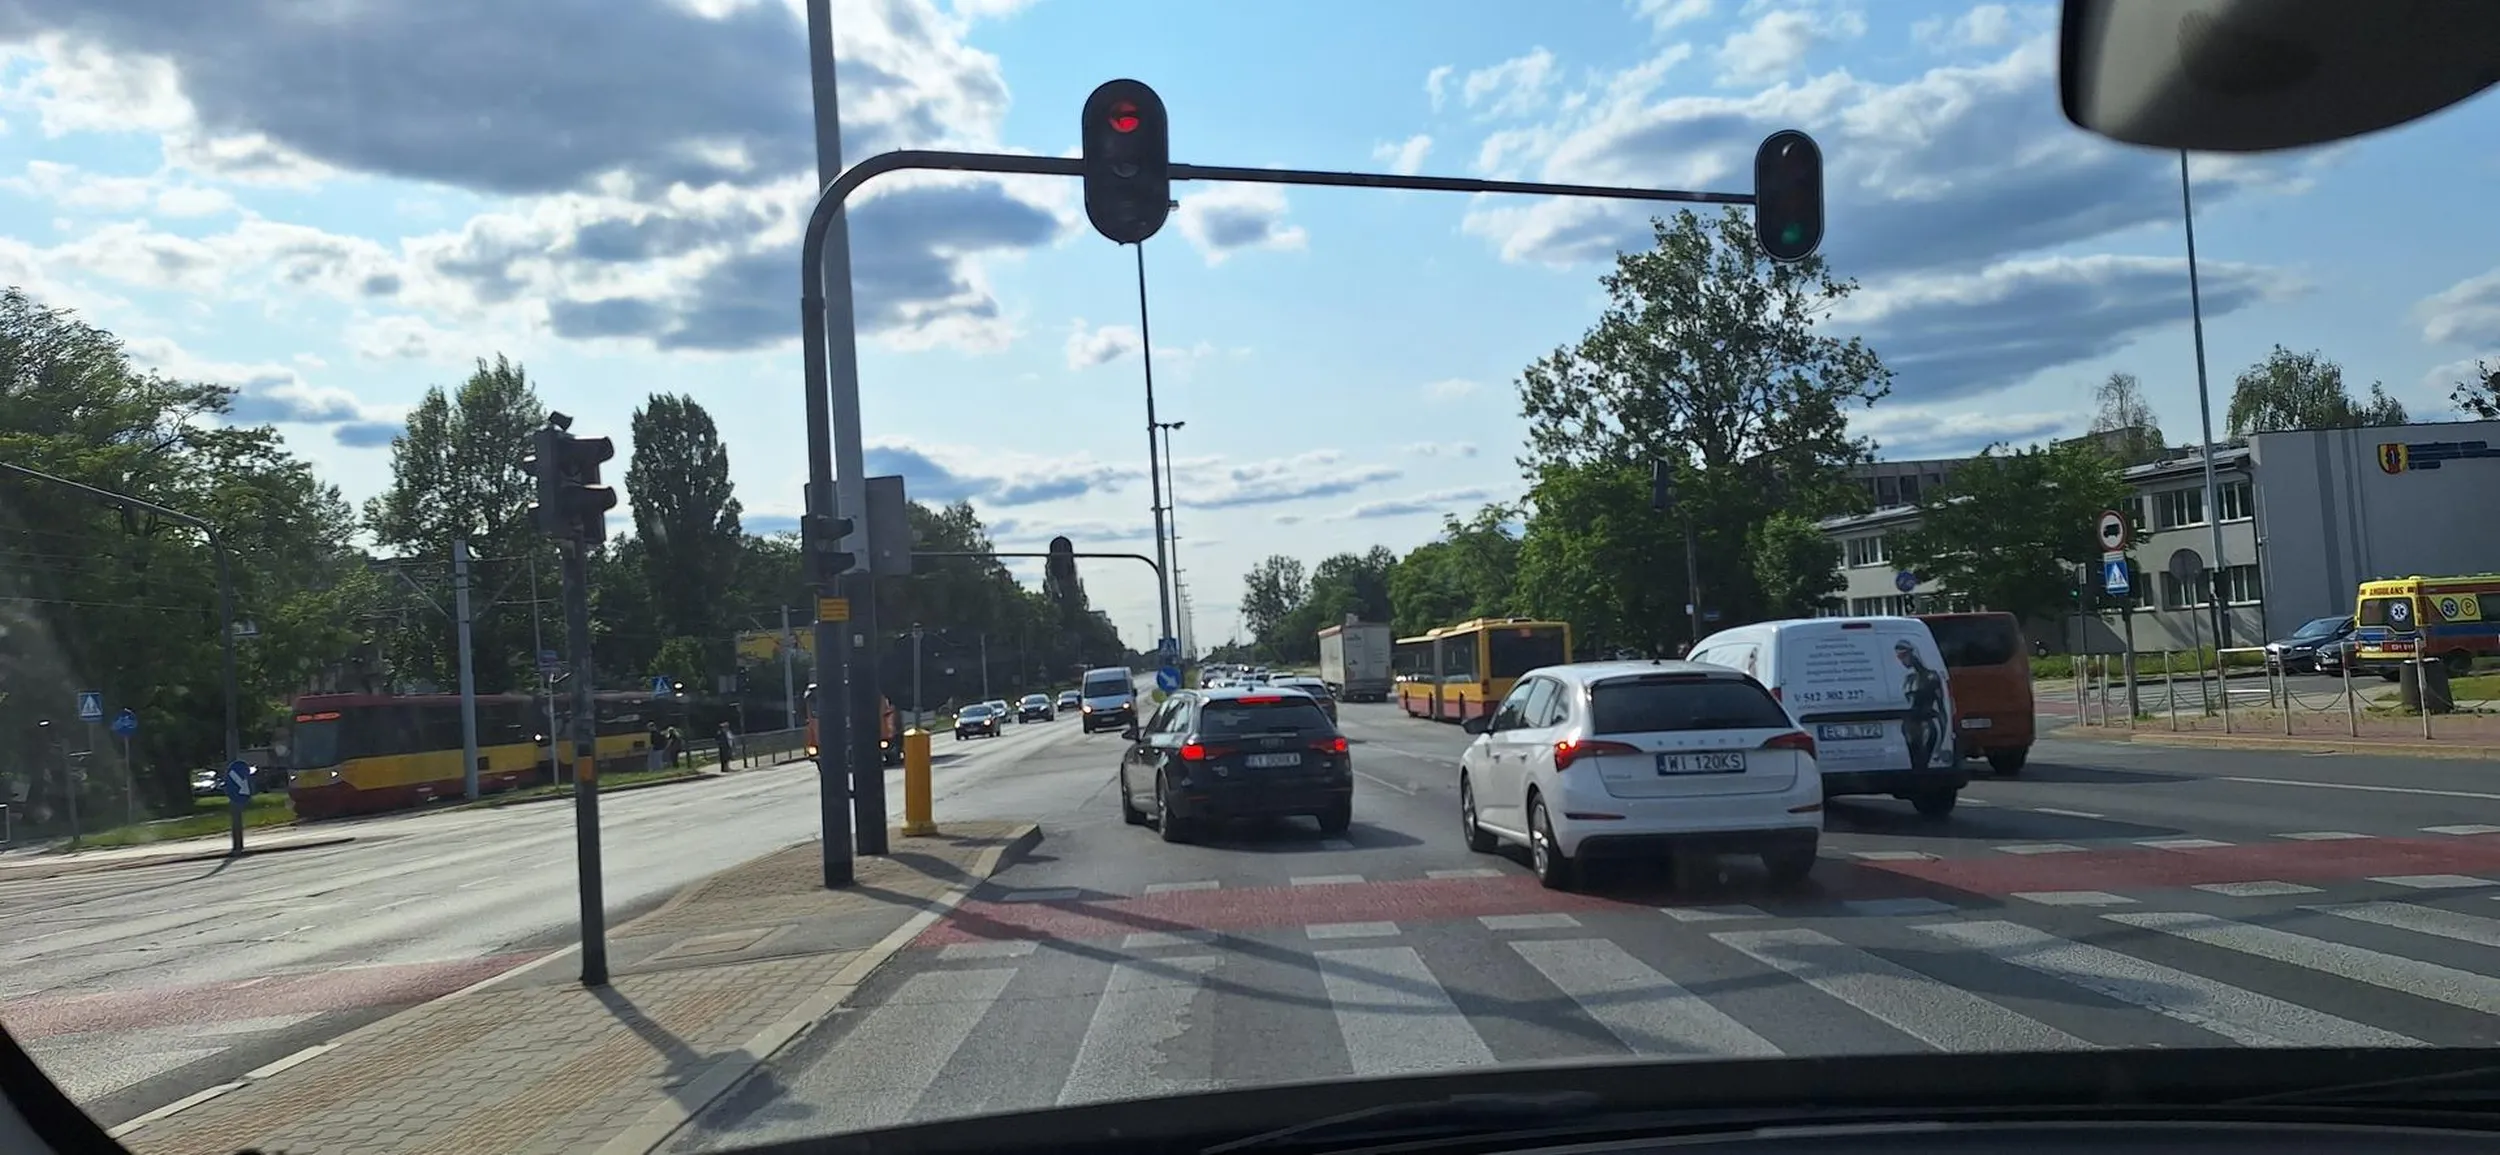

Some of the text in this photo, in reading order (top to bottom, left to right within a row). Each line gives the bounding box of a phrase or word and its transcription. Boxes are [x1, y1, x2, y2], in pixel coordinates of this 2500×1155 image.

[1803, 692, 1821, 702] 512
[1847, 689, 1865, 700] 227
[1667, 754, 1741, 770] WI 120KS
